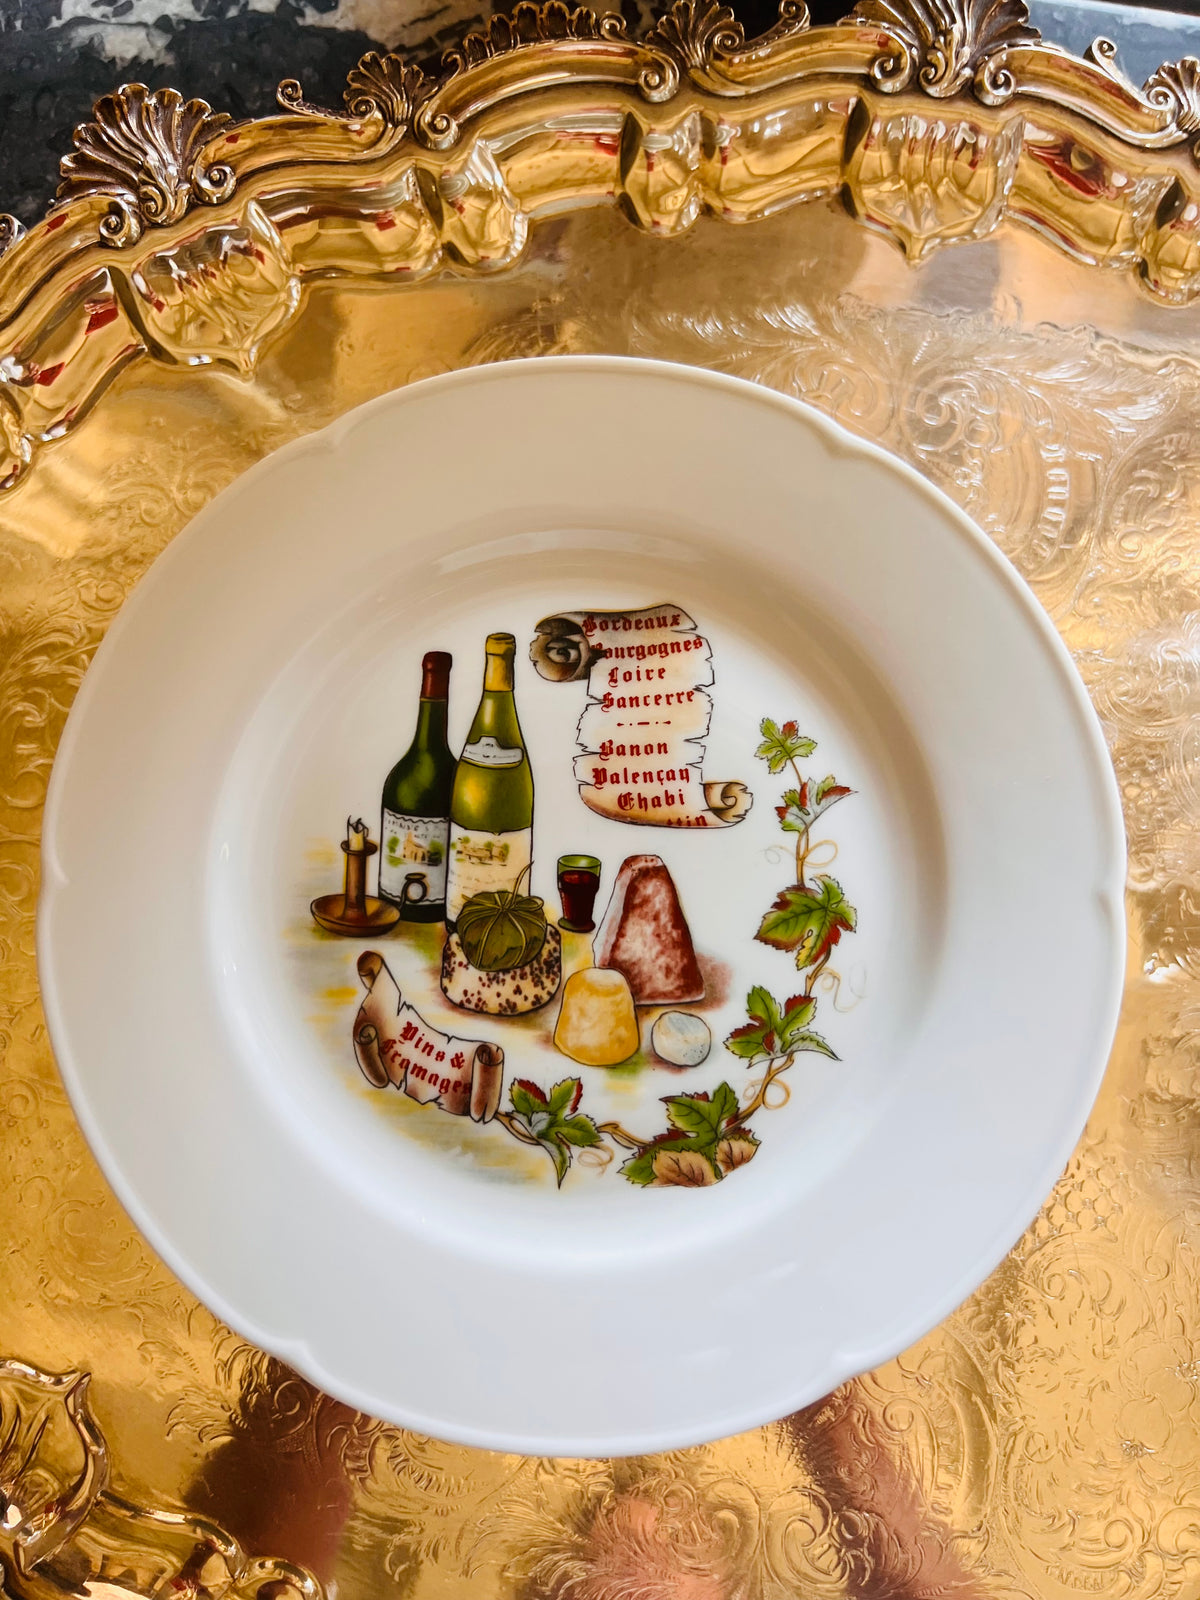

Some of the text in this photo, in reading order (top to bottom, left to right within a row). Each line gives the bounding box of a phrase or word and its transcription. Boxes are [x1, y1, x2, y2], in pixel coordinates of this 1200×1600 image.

[582, 614, 681, 638] Bordeaux
[608, 666, 667, 687] Loire
[601, 690, 695, 712] Sancerre
[599, 740, 669, 761] Banon
[592, 768, 690, 789] Valençay
[617, 789, 686, 812] Chabi
[398, 1020, 466, 1070] Vins &
